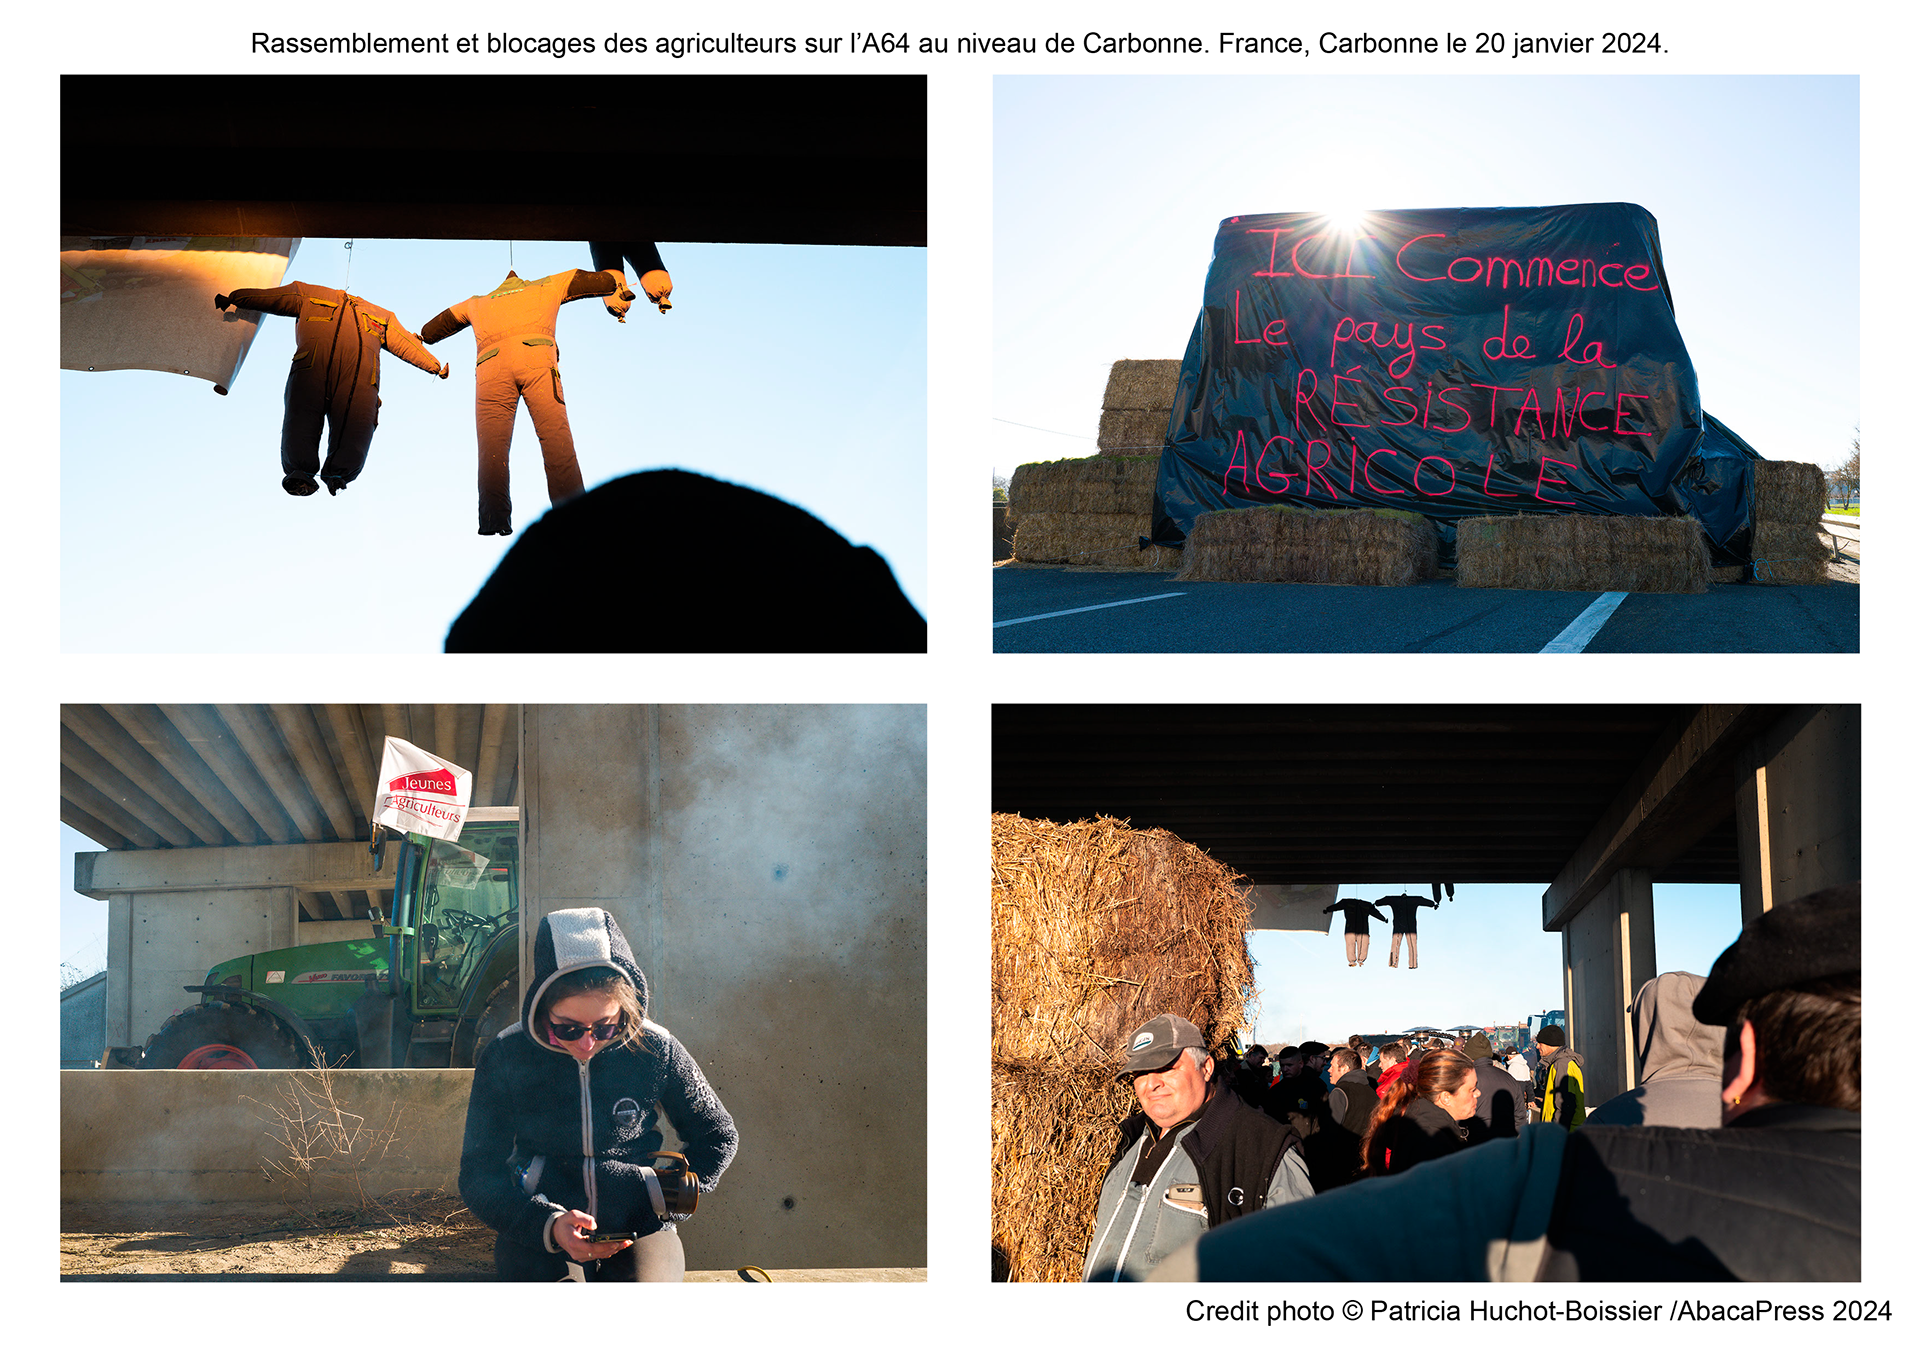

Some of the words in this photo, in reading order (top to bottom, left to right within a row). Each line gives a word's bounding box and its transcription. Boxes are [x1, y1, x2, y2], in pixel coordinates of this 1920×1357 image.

[1246, 228, 1378, 279] ICI
[1234, 289, 1289, 346] Le
[1330, 316, 1447, 380] pays
[1482, 304, 1537, 361] de
[1557, 313, 1618, 370] la
[402, 776, 452, 791] Jeunes
[391, 794, 461, 823] Agriculteurs
